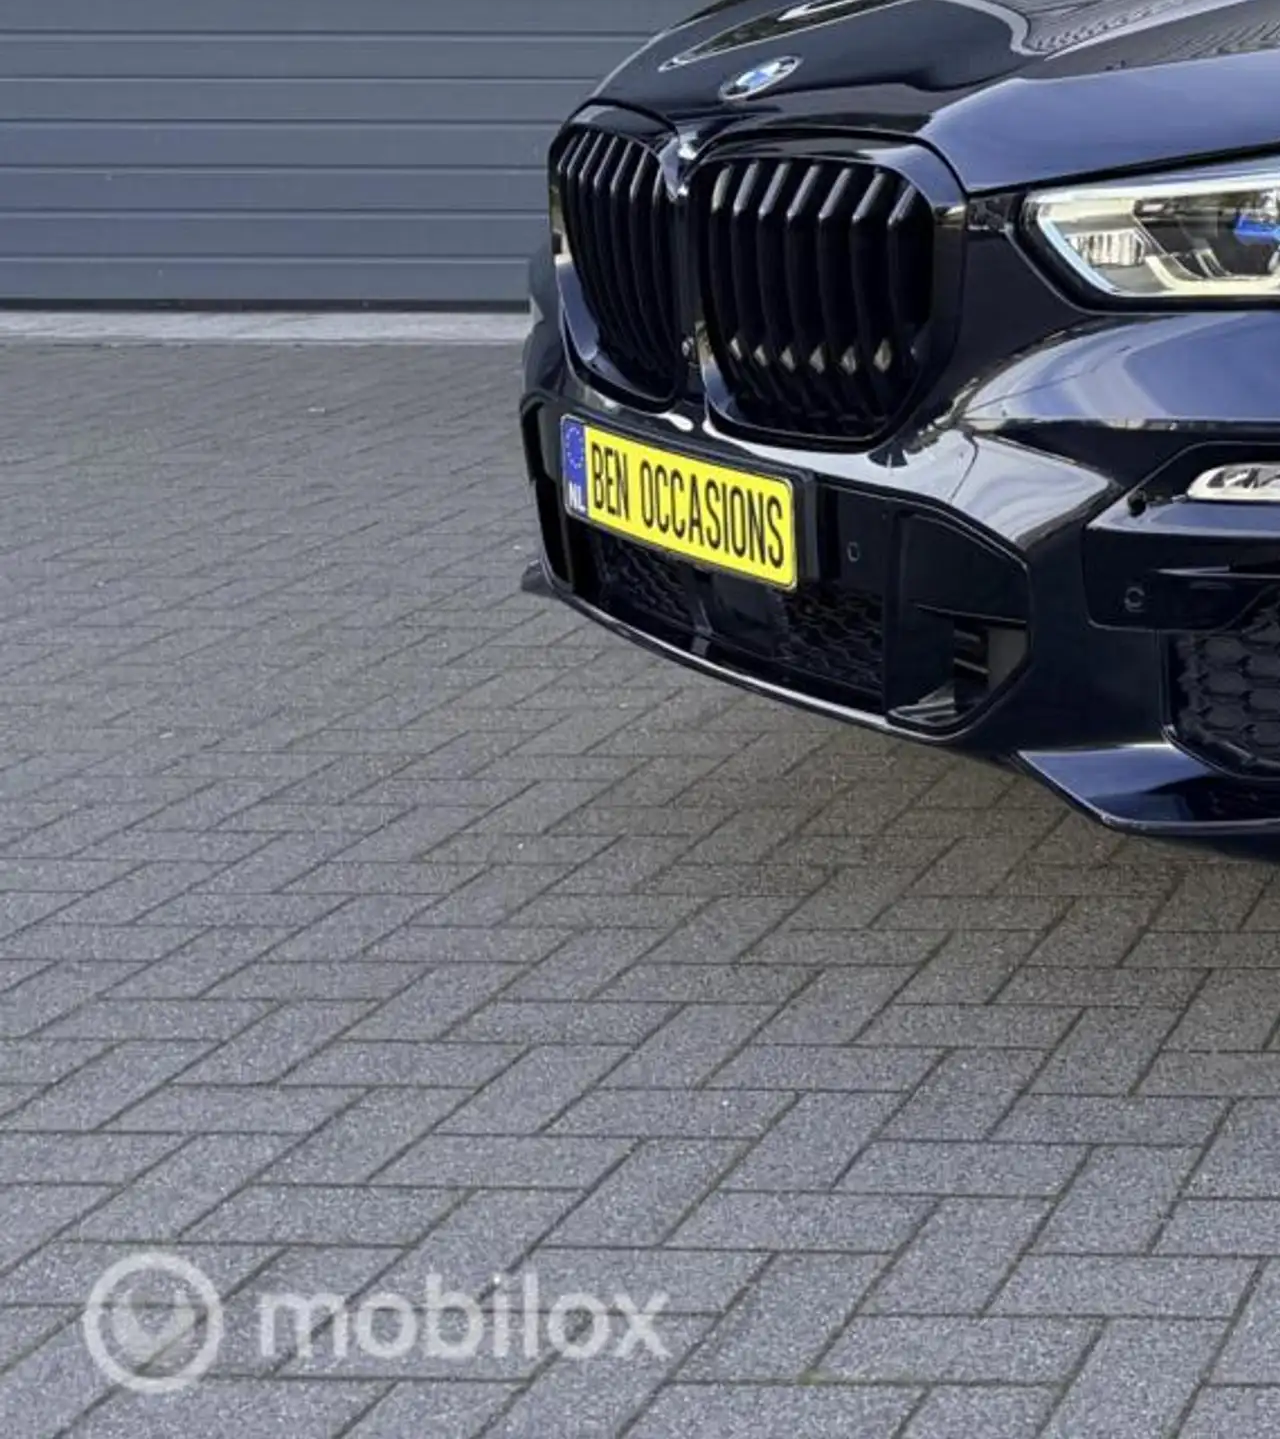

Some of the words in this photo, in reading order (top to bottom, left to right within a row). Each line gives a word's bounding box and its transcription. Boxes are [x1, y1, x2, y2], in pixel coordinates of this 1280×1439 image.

[568, 480, 586, 512] NL
[591, 441, 630, 522] BEN
[639, 459, 785, 569] OCCASIONS
